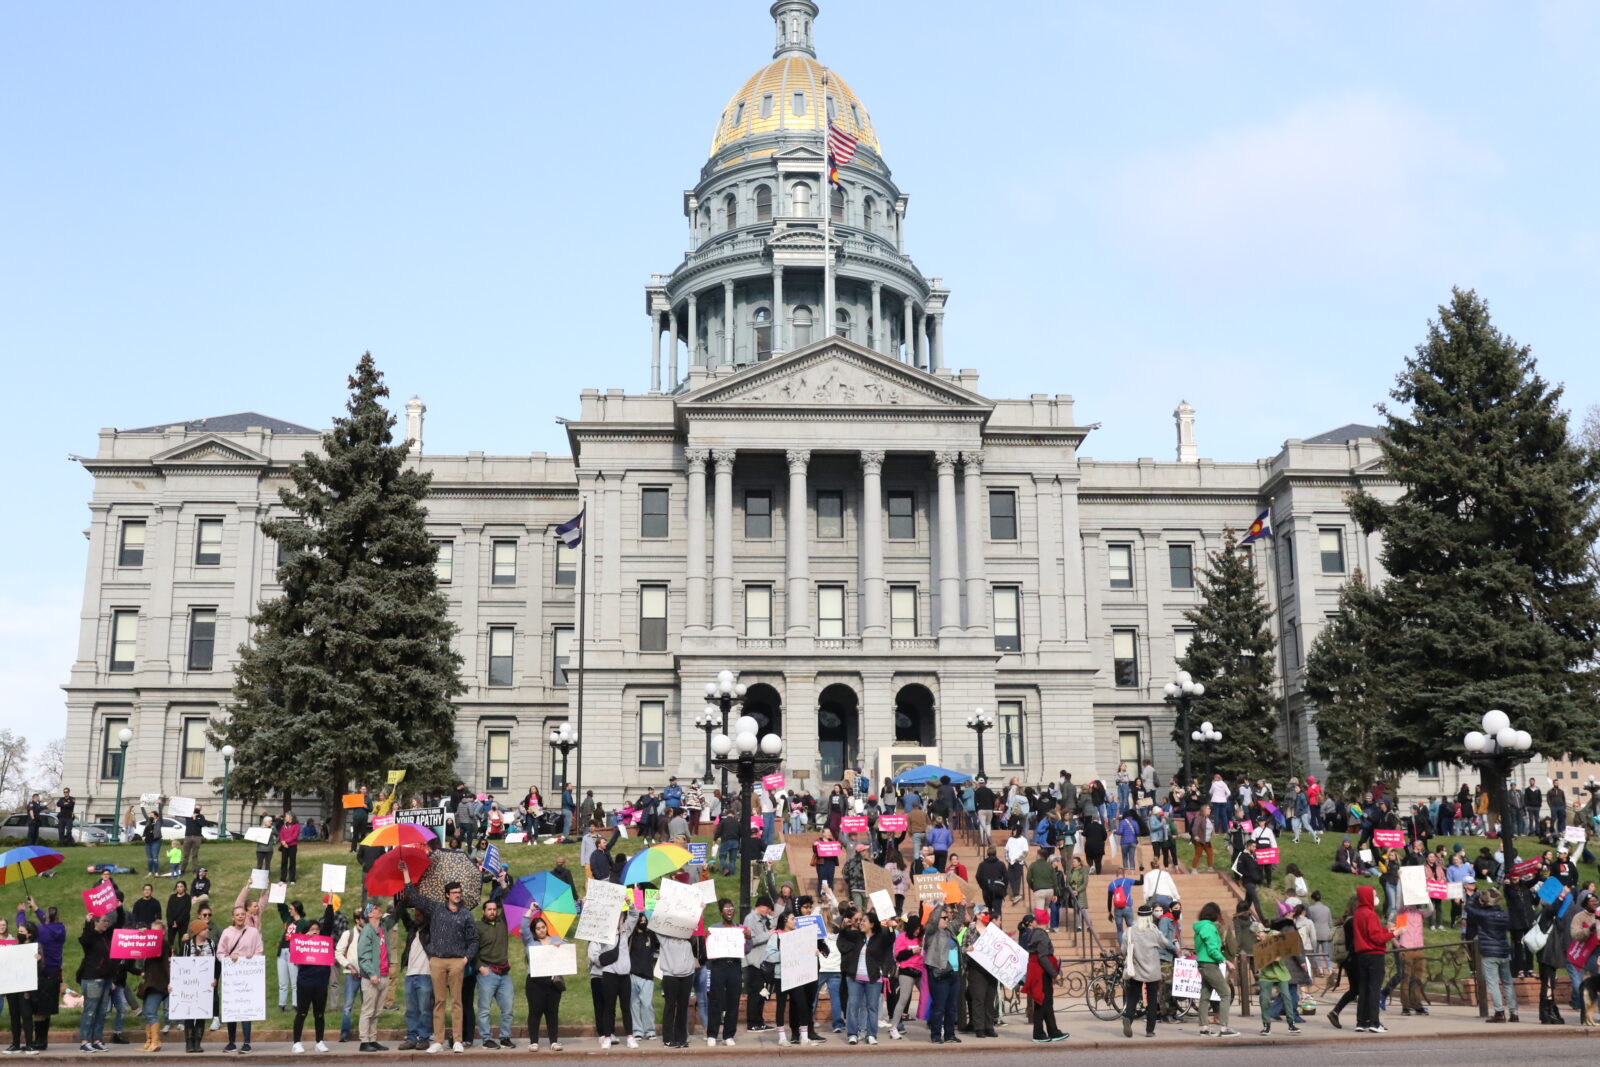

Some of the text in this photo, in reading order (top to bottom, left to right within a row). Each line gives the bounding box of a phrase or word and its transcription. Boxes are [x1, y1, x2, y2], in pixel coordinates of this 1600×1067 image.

[396, 816, 414, 824] YOUR
[416, 814, 444, 826] APATHY
[1175, 968, 1192, 978] SAFE
